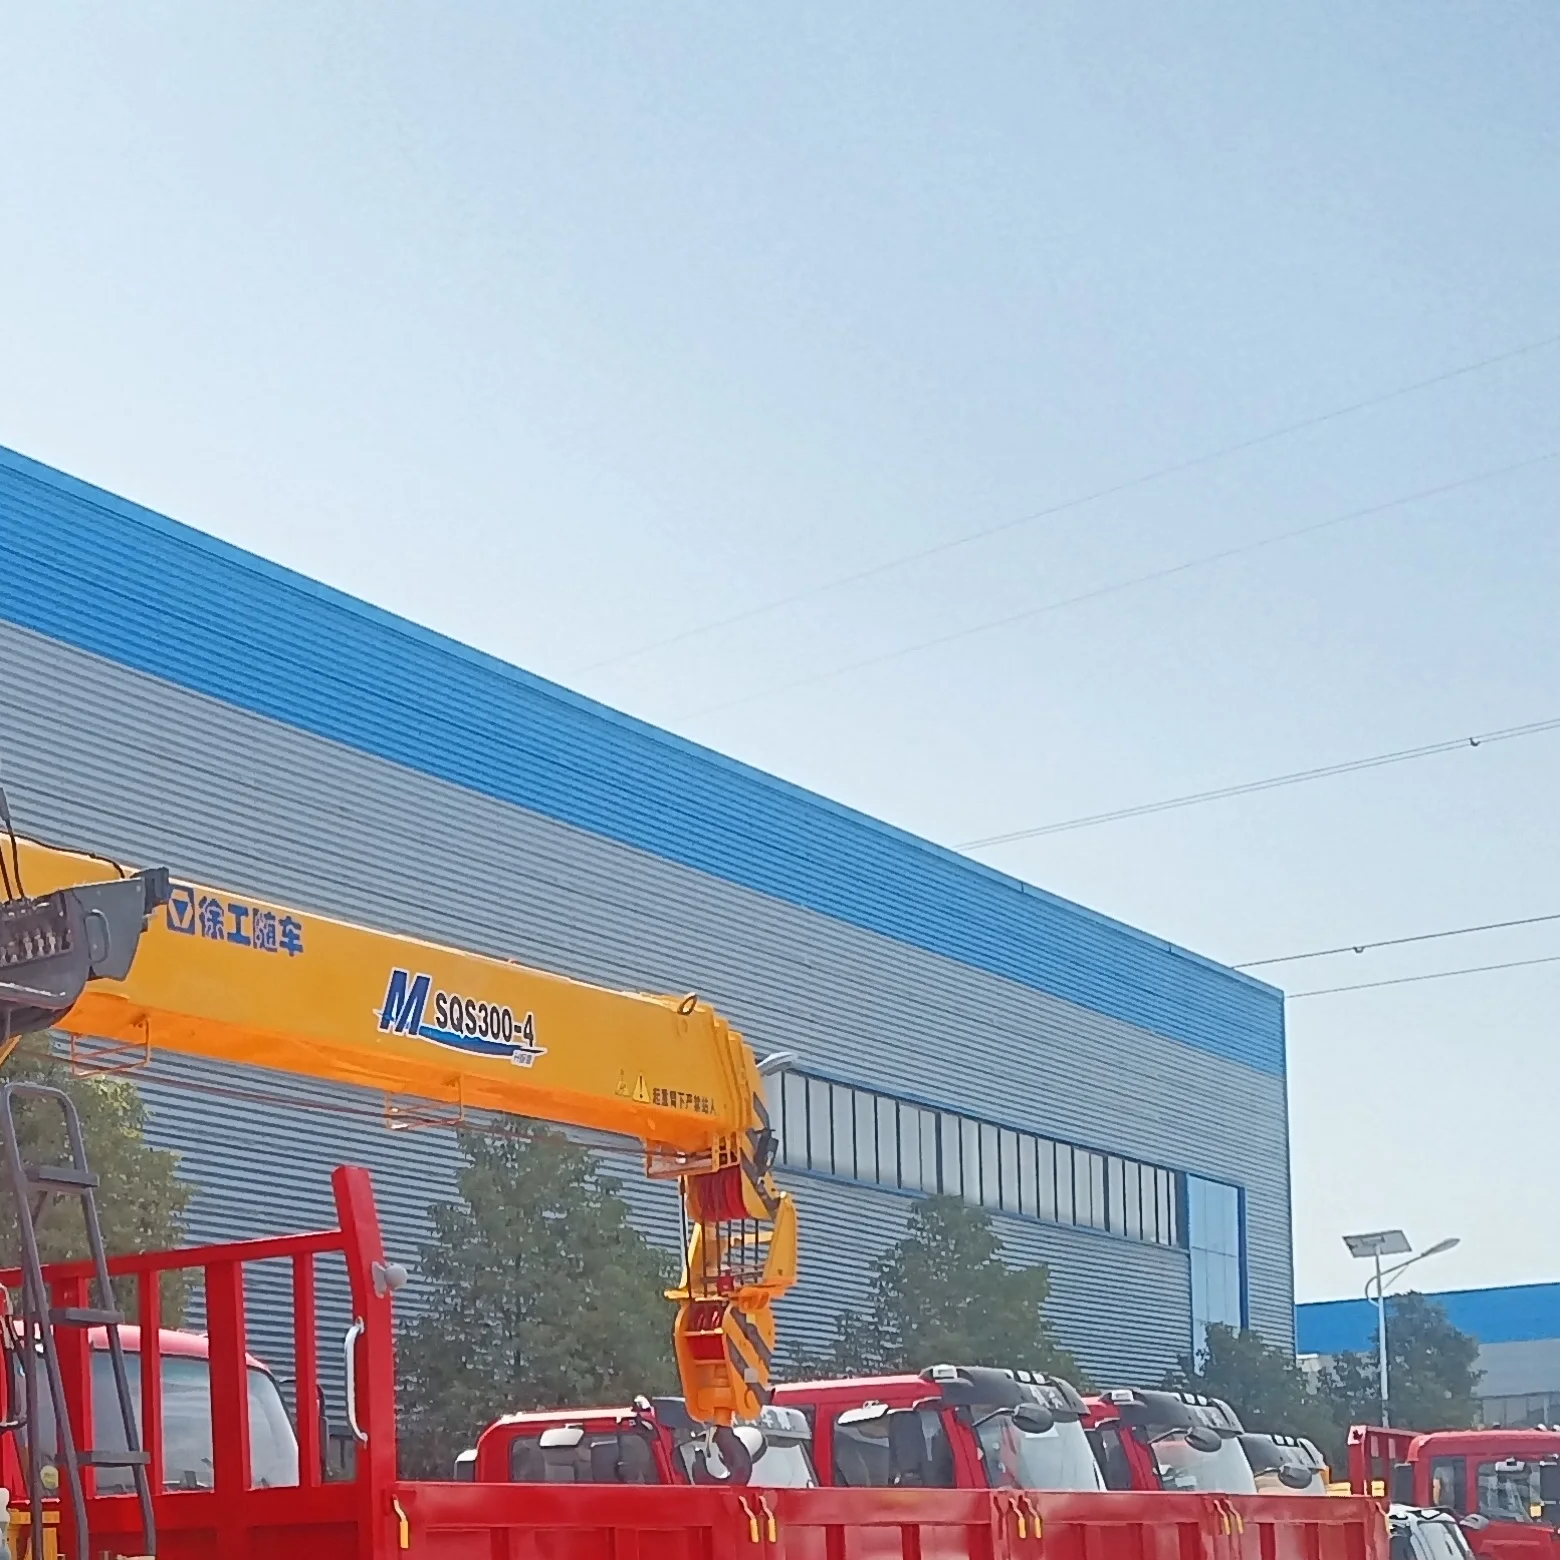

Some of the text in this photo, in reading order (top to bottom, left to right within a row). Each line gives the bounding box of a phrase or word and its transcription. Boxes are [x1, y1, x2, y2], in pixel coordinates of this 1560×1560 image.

[198, 896, 304, 957] 徐工随车
[435, 992, 535, 1048] SQS300-4
